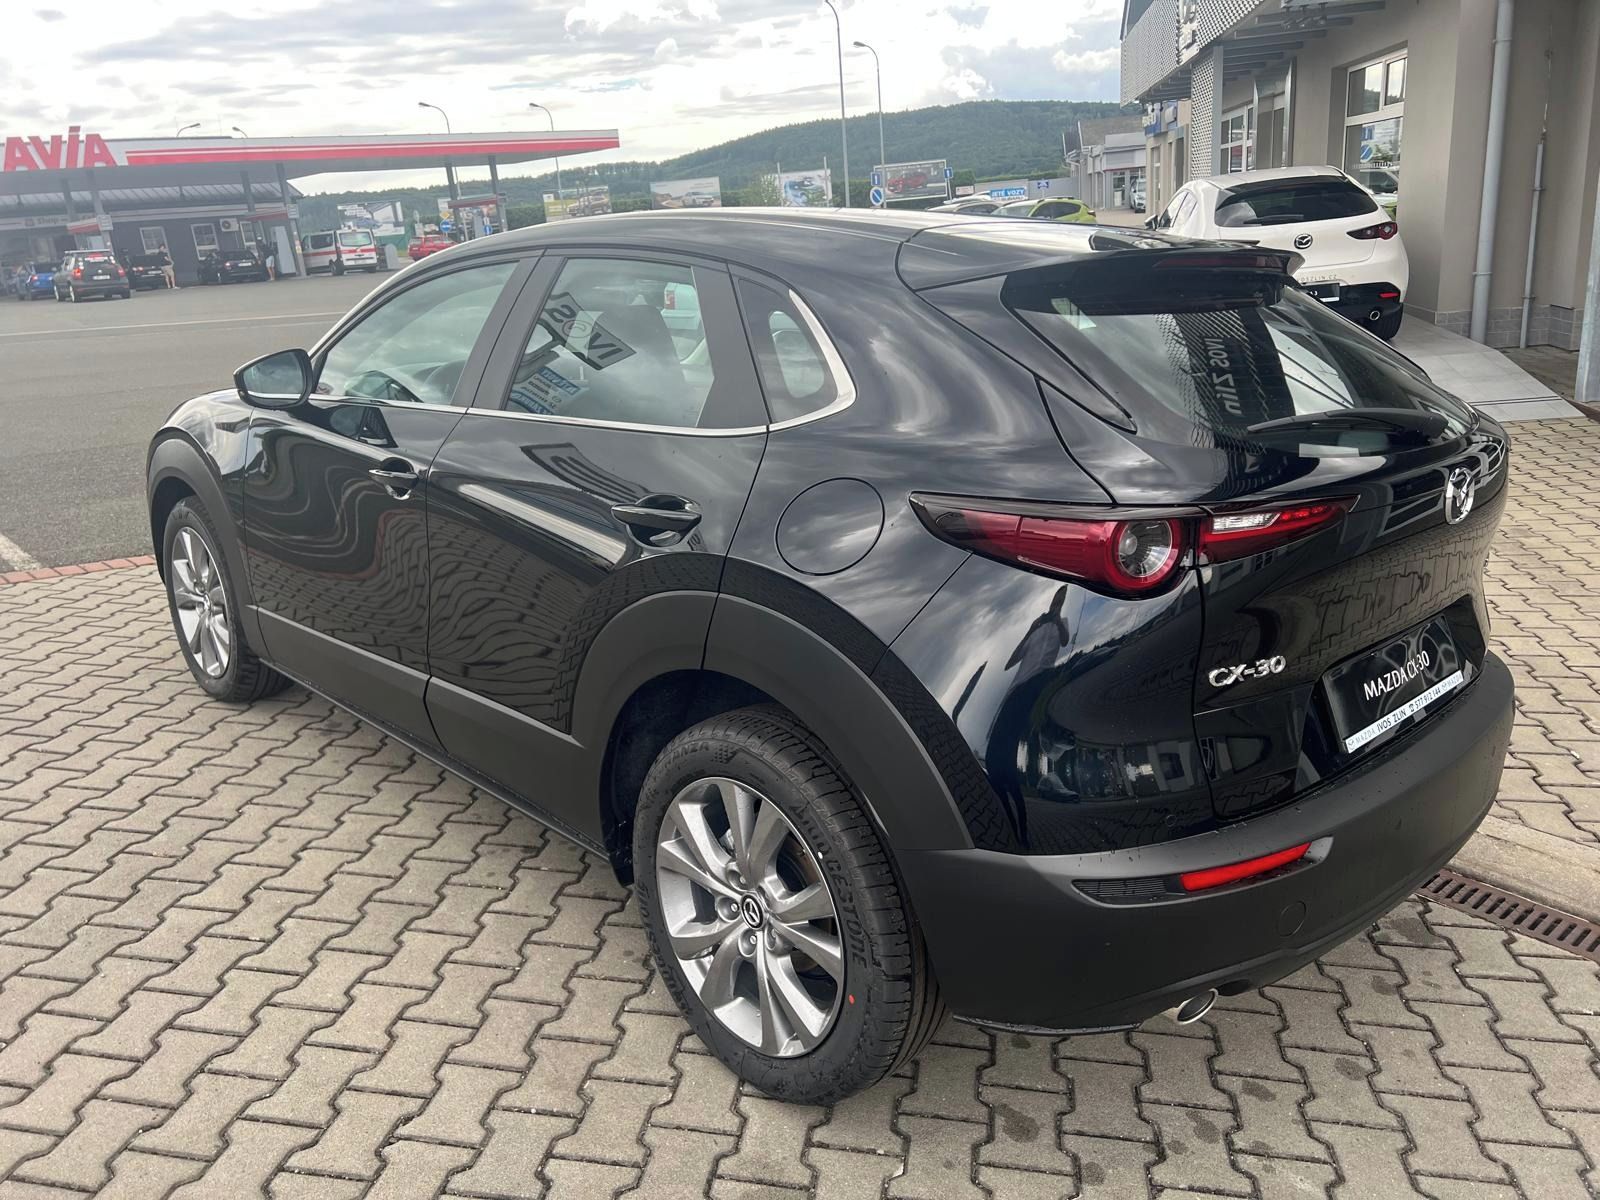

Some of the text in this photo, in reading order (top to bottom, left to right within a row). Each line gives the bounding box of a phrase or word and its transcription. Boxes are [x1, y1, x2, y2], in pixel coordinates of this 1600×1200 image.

[1208, 655, 1286, 687] CX-30
[1363, 650, 1430, 701] MAZDA CX-30
[1376, 717, 1391, 733] IVOS
